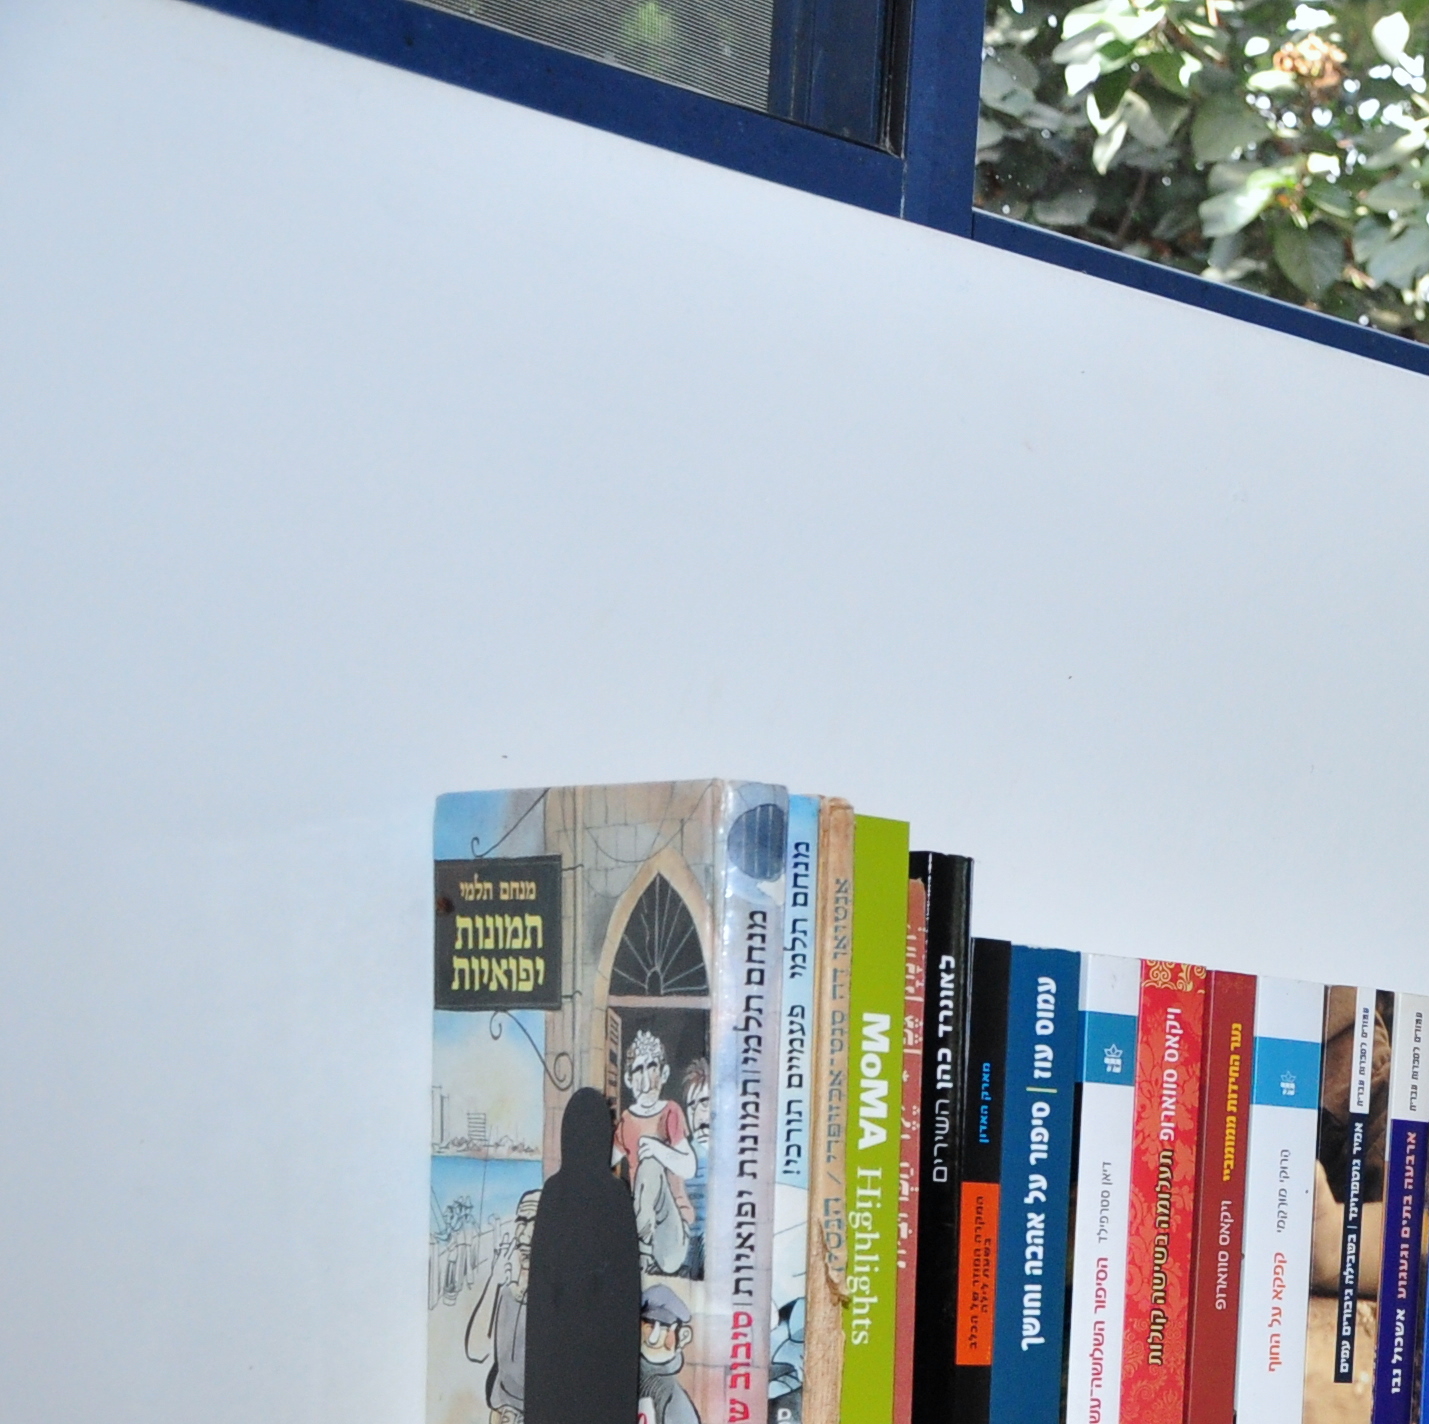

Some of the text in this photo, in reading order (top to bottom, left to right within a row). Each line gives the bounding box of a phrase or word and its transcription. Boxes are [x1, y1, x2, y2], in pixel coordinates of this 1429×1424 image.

[460, 873, 537, 901] מנחם תלמי
[783, 839, 810, 979] מנחם תלמי
[455, 913, 543, 950] תמונות
[451, 955, 545, 992] יפואיות
[831, 966, 846, 999] דה
[1032, 976, 1056, 1079] עמוס עוז
[1229, 1023, 1242, 1051] נער
[731, 908, 769, 1297] מנחם תלמי תמונות יפואיות
[783, 1003, 806, 1176] פעמיים תורכי!
[932, 955, 955, 1183] לאונרד כהן השירים
[979, 1062, 992, 1143] מארק האדון
[1159, 1008, 1182, 1141] ויקאס סווארופ
[1226, 1054, 1240, 1112] החידות
[1356, 1080, 1365, 1107] עברית
[1409, 1084, 1418, 1111] עברית
[1352, 1122, 1365, 1153] אמיר
[848, 1012, 892, 1346] MoMA Highlights
[1097, 1161, 1112, 1244] דיאן סטרפילד
[1275, 1149, 1290, 1233] הרוקי מורקמי
[1020, 1101, 1050, 1351] סיפור על אהבה וחושך
[1146, 1150, 1174, 1365] תעלומה בשישה קולות
[1215, 1200, 1234, 1310] ויקאס סווארופ
[1344, 1233, 1358, 1284] בשבילה
[1390, 1132, 1417, 1394] ארבעה בתים וגעגוע אשכול נבו
[968, 1196, 986, 1350] המקרה המוזר של הכלב
[980, 1238, 991, 1313] בשעת לילה
[1093, 1257, 1108, 1314] הסיפור
[1268, 1252, 1288, 1372] קפקא על החוף
[1341, 1288, 1354, 1336] גיבורים
[727, 1310, 753, 1390] סיבוב
[1339, 1340, 1351, 1373] עפים
